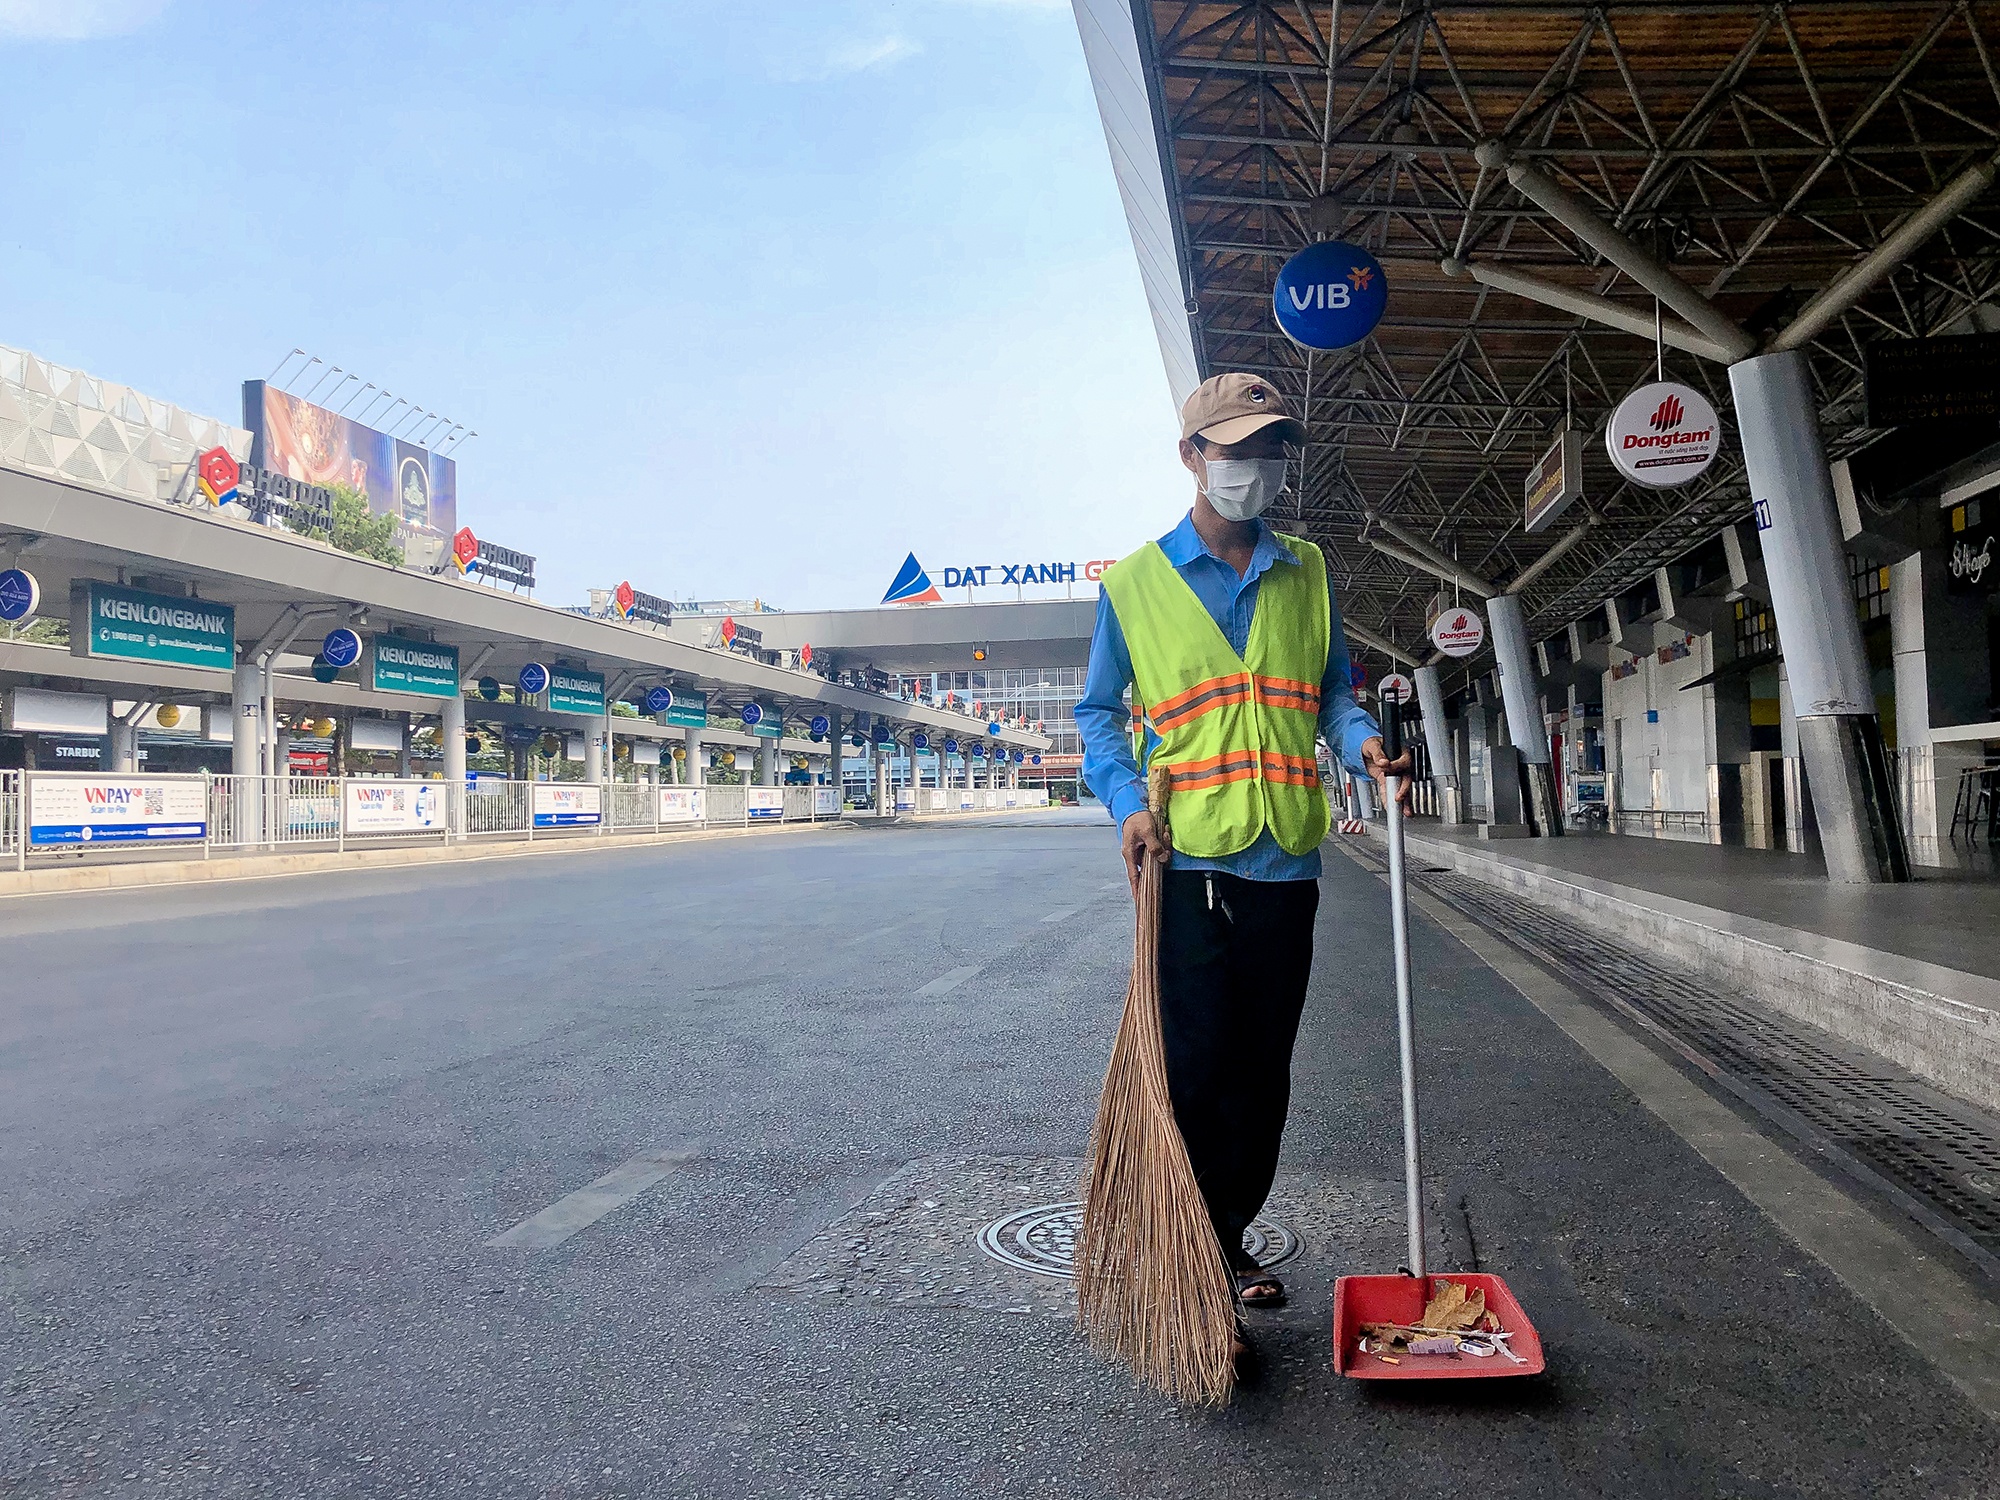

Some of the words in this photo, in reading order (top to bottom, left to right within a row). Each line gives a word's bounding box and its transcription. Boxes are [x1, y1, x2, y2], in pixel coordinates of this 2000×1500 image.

[1289, 283, 1351, 311] VIB
[1623, 430, 1710, 450] Dongtam
[1638, 455, 1705, 467] www.dongtam.com.vn
[239, 462, 336, 512] PHATDAT
[477, 539, 537, 573] PHATDAT
[944, 565, 991, 588] DAT
[1001, 561, 1075, 585] XANH
[99, 597, 226, 635] KIENLONGBANK
[379, 646, 454, 671] KIENLONGBANK
